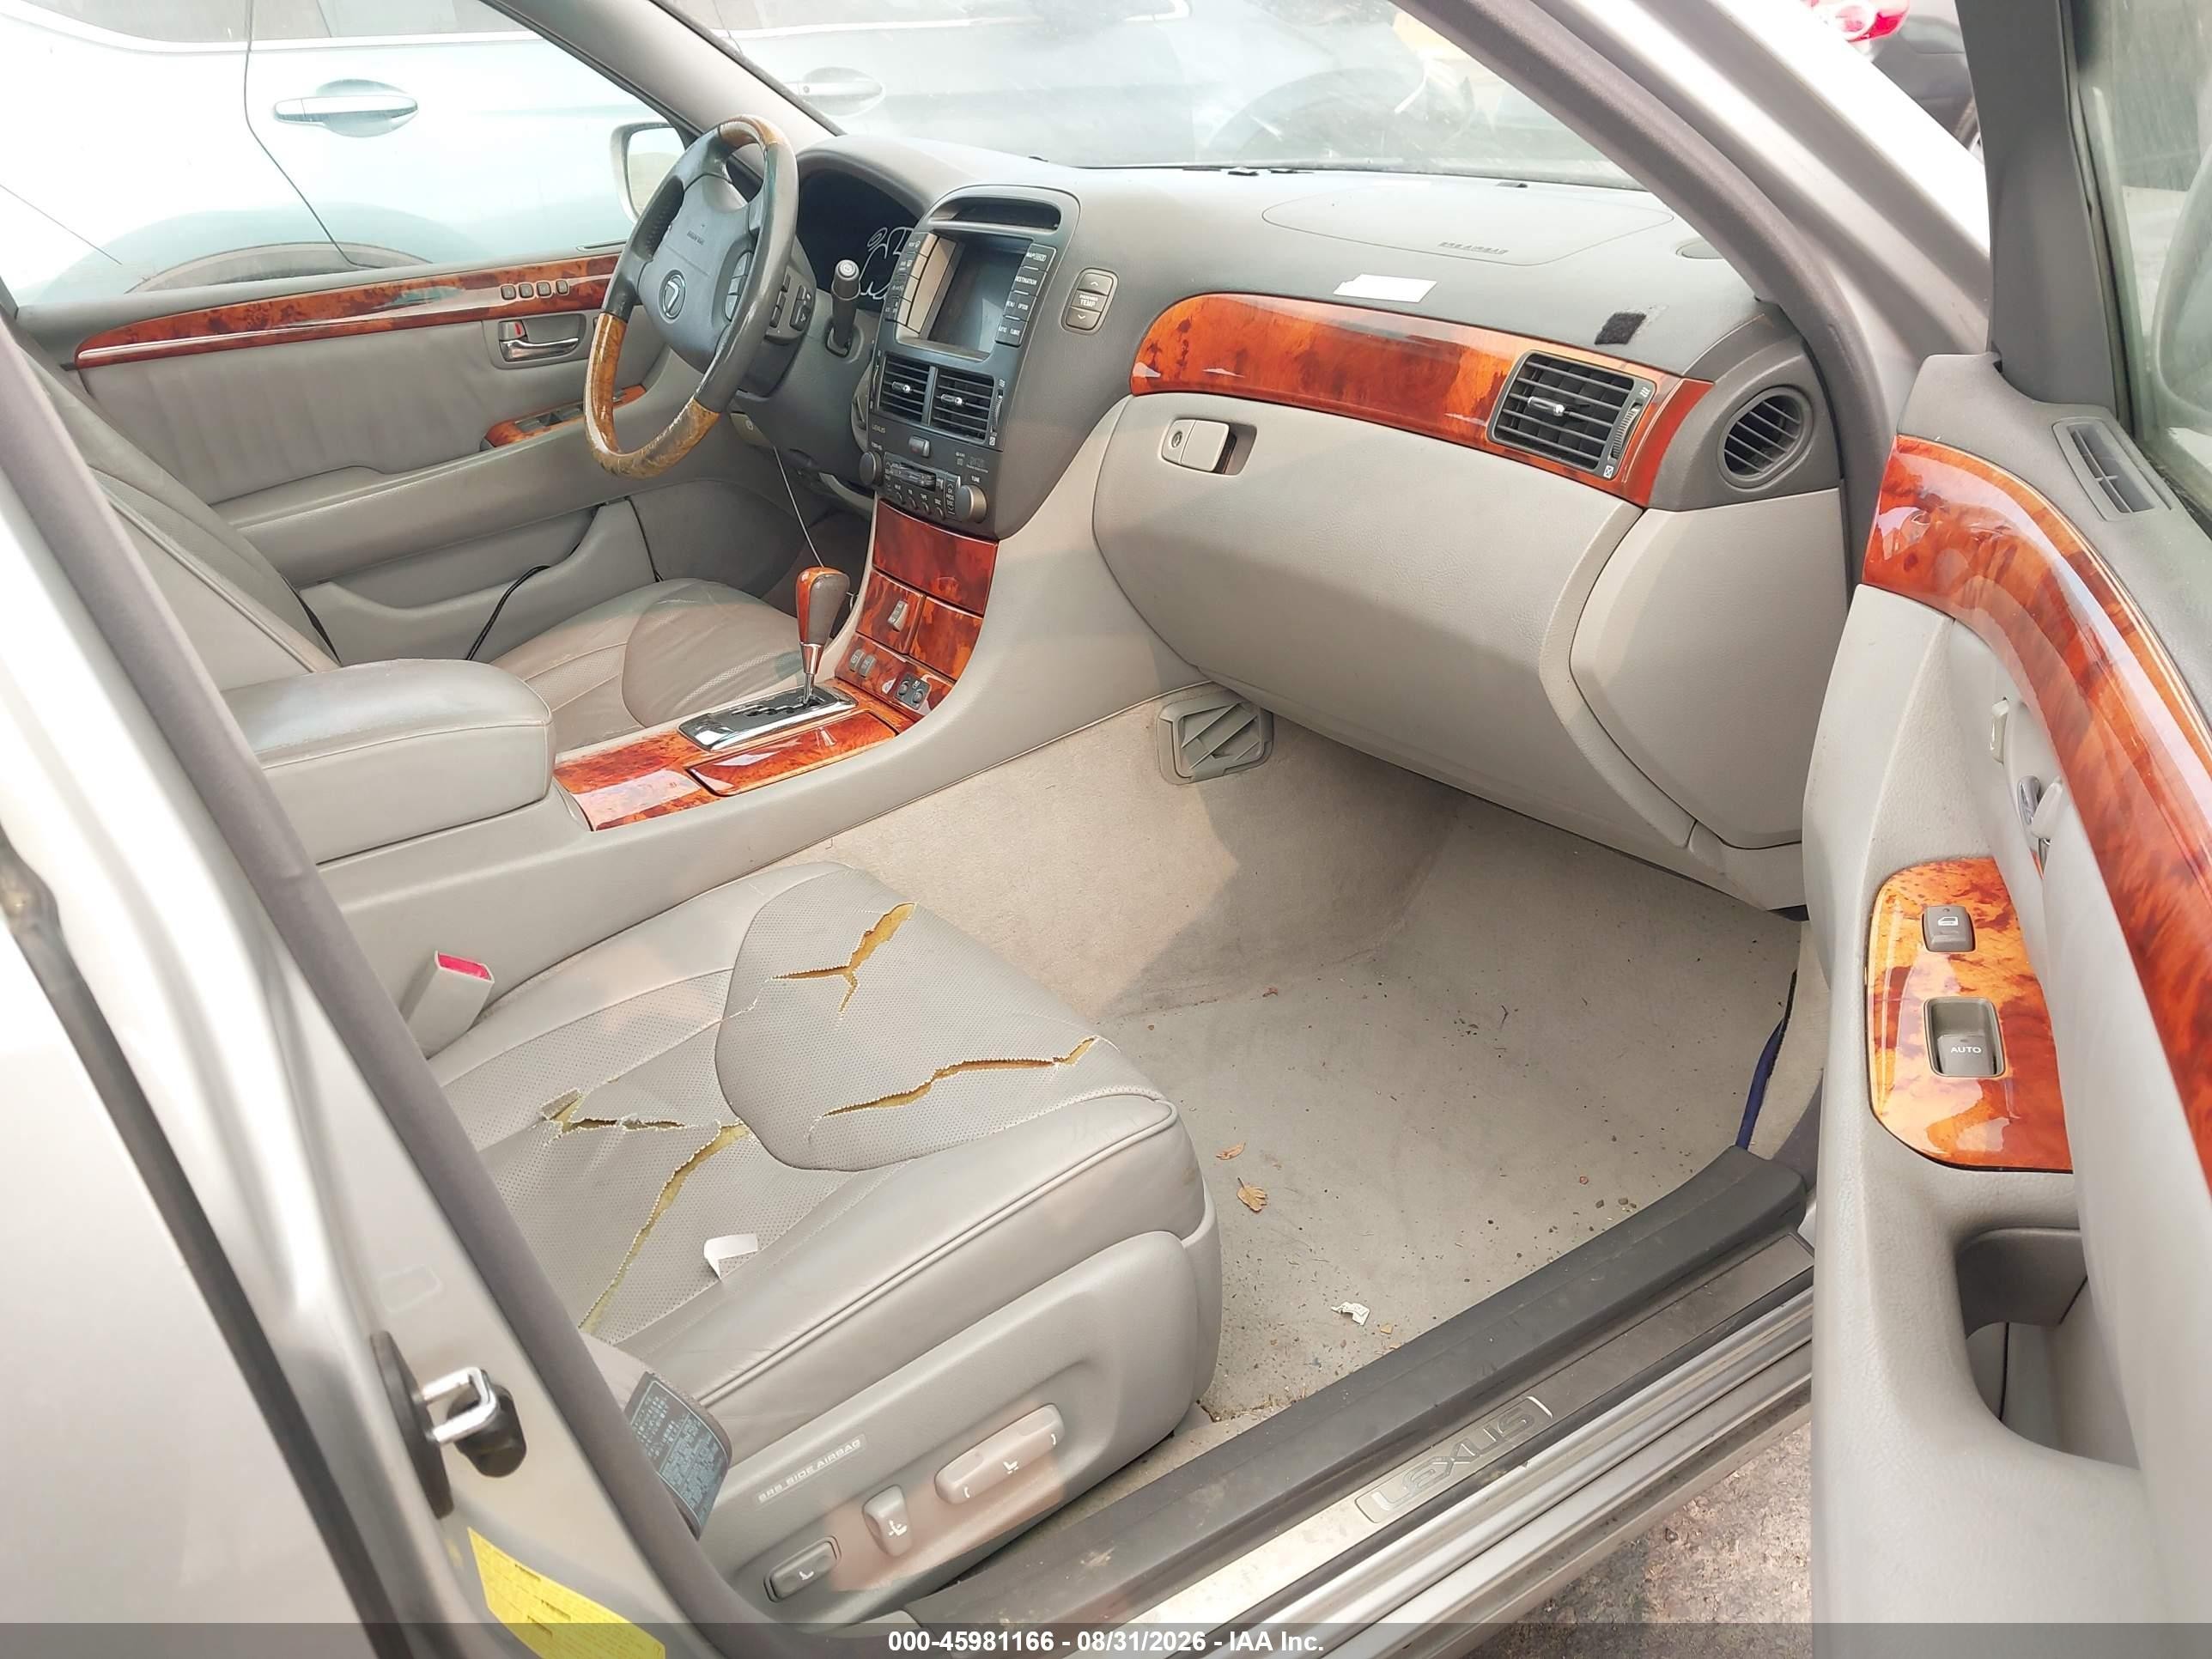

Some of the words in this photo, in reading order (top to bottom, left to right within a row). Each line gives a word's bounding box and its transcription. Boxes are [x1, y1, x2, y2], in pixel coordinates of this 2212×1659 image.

[1080, 299, 1096, 307] TEMP
[786, 1466, 816, 1486] SIDE
[817, 1439, 861, 1469] AIRBAG
[1370, 1407, 1535, 1511] LEXUS
